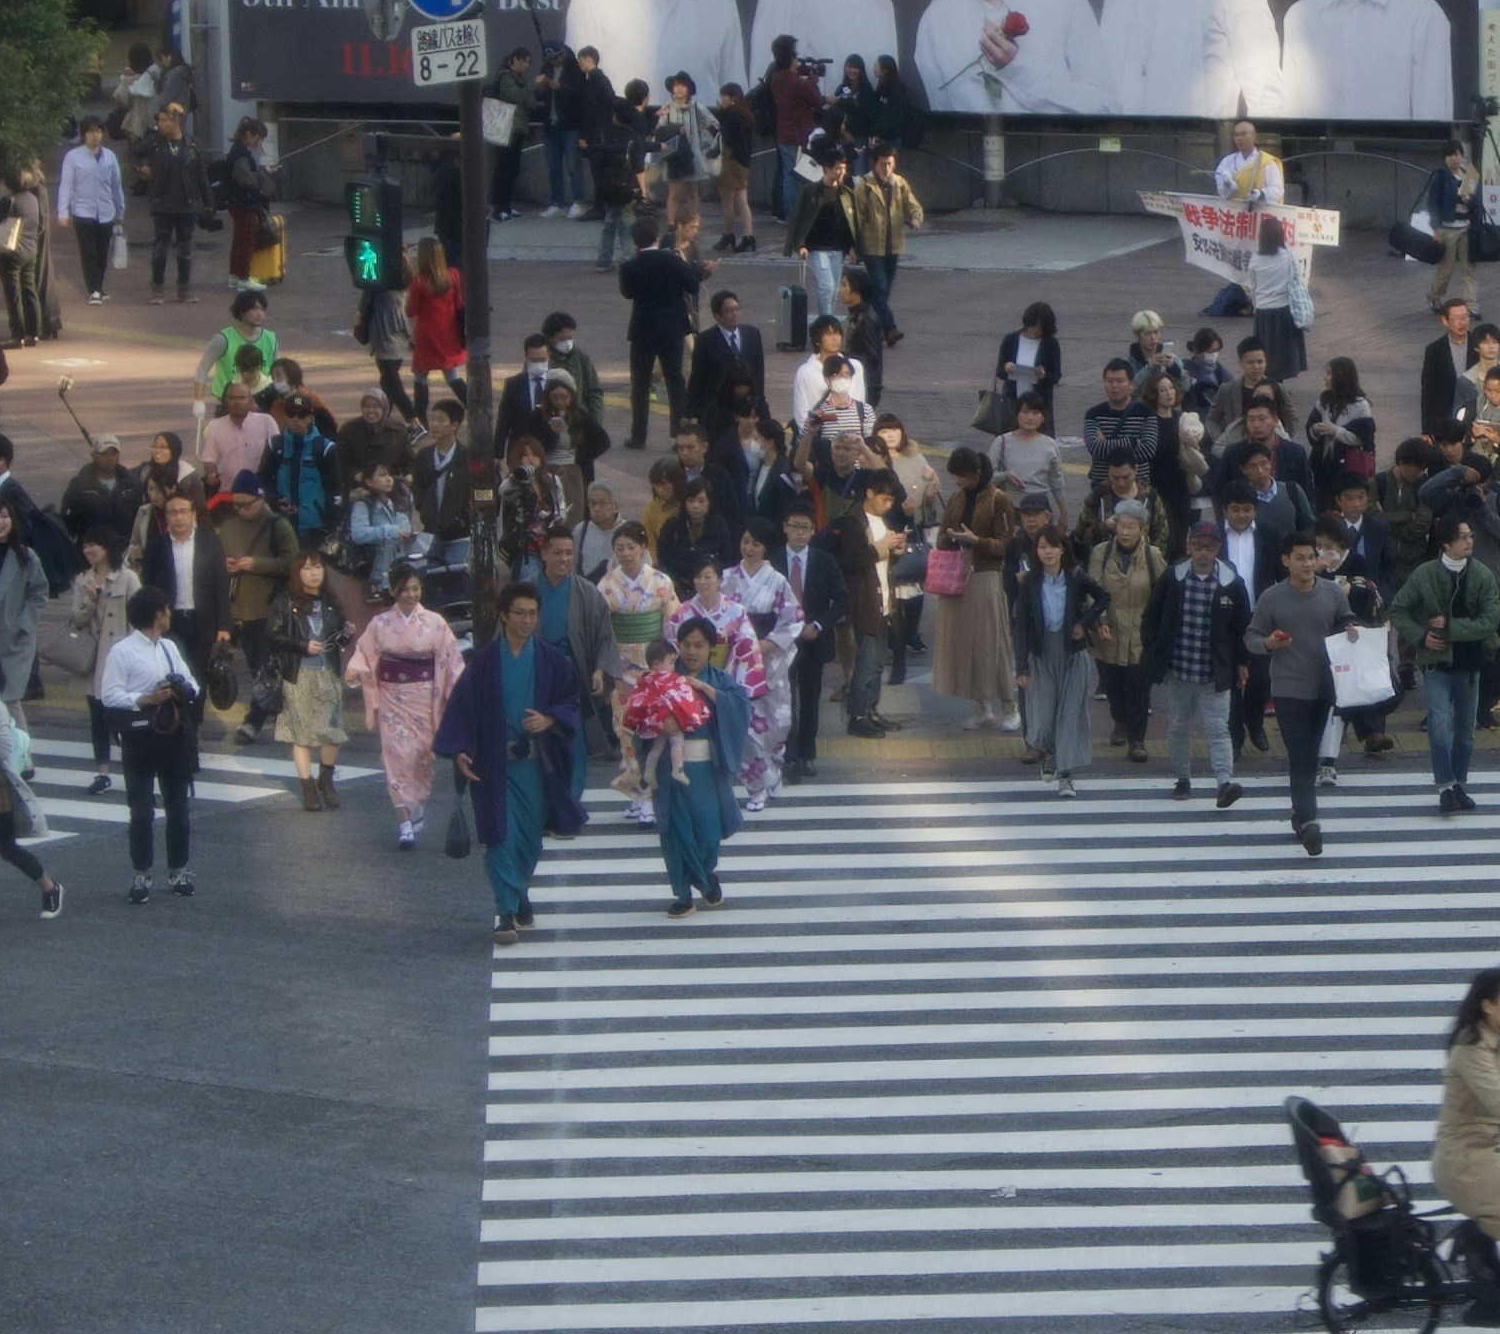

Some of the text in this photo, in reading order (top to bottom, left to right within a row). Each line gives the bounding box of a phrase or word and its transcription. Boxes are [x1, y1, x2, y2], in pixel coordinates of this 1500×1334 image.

[416, 27, 479, 52] 路線バスを除く
